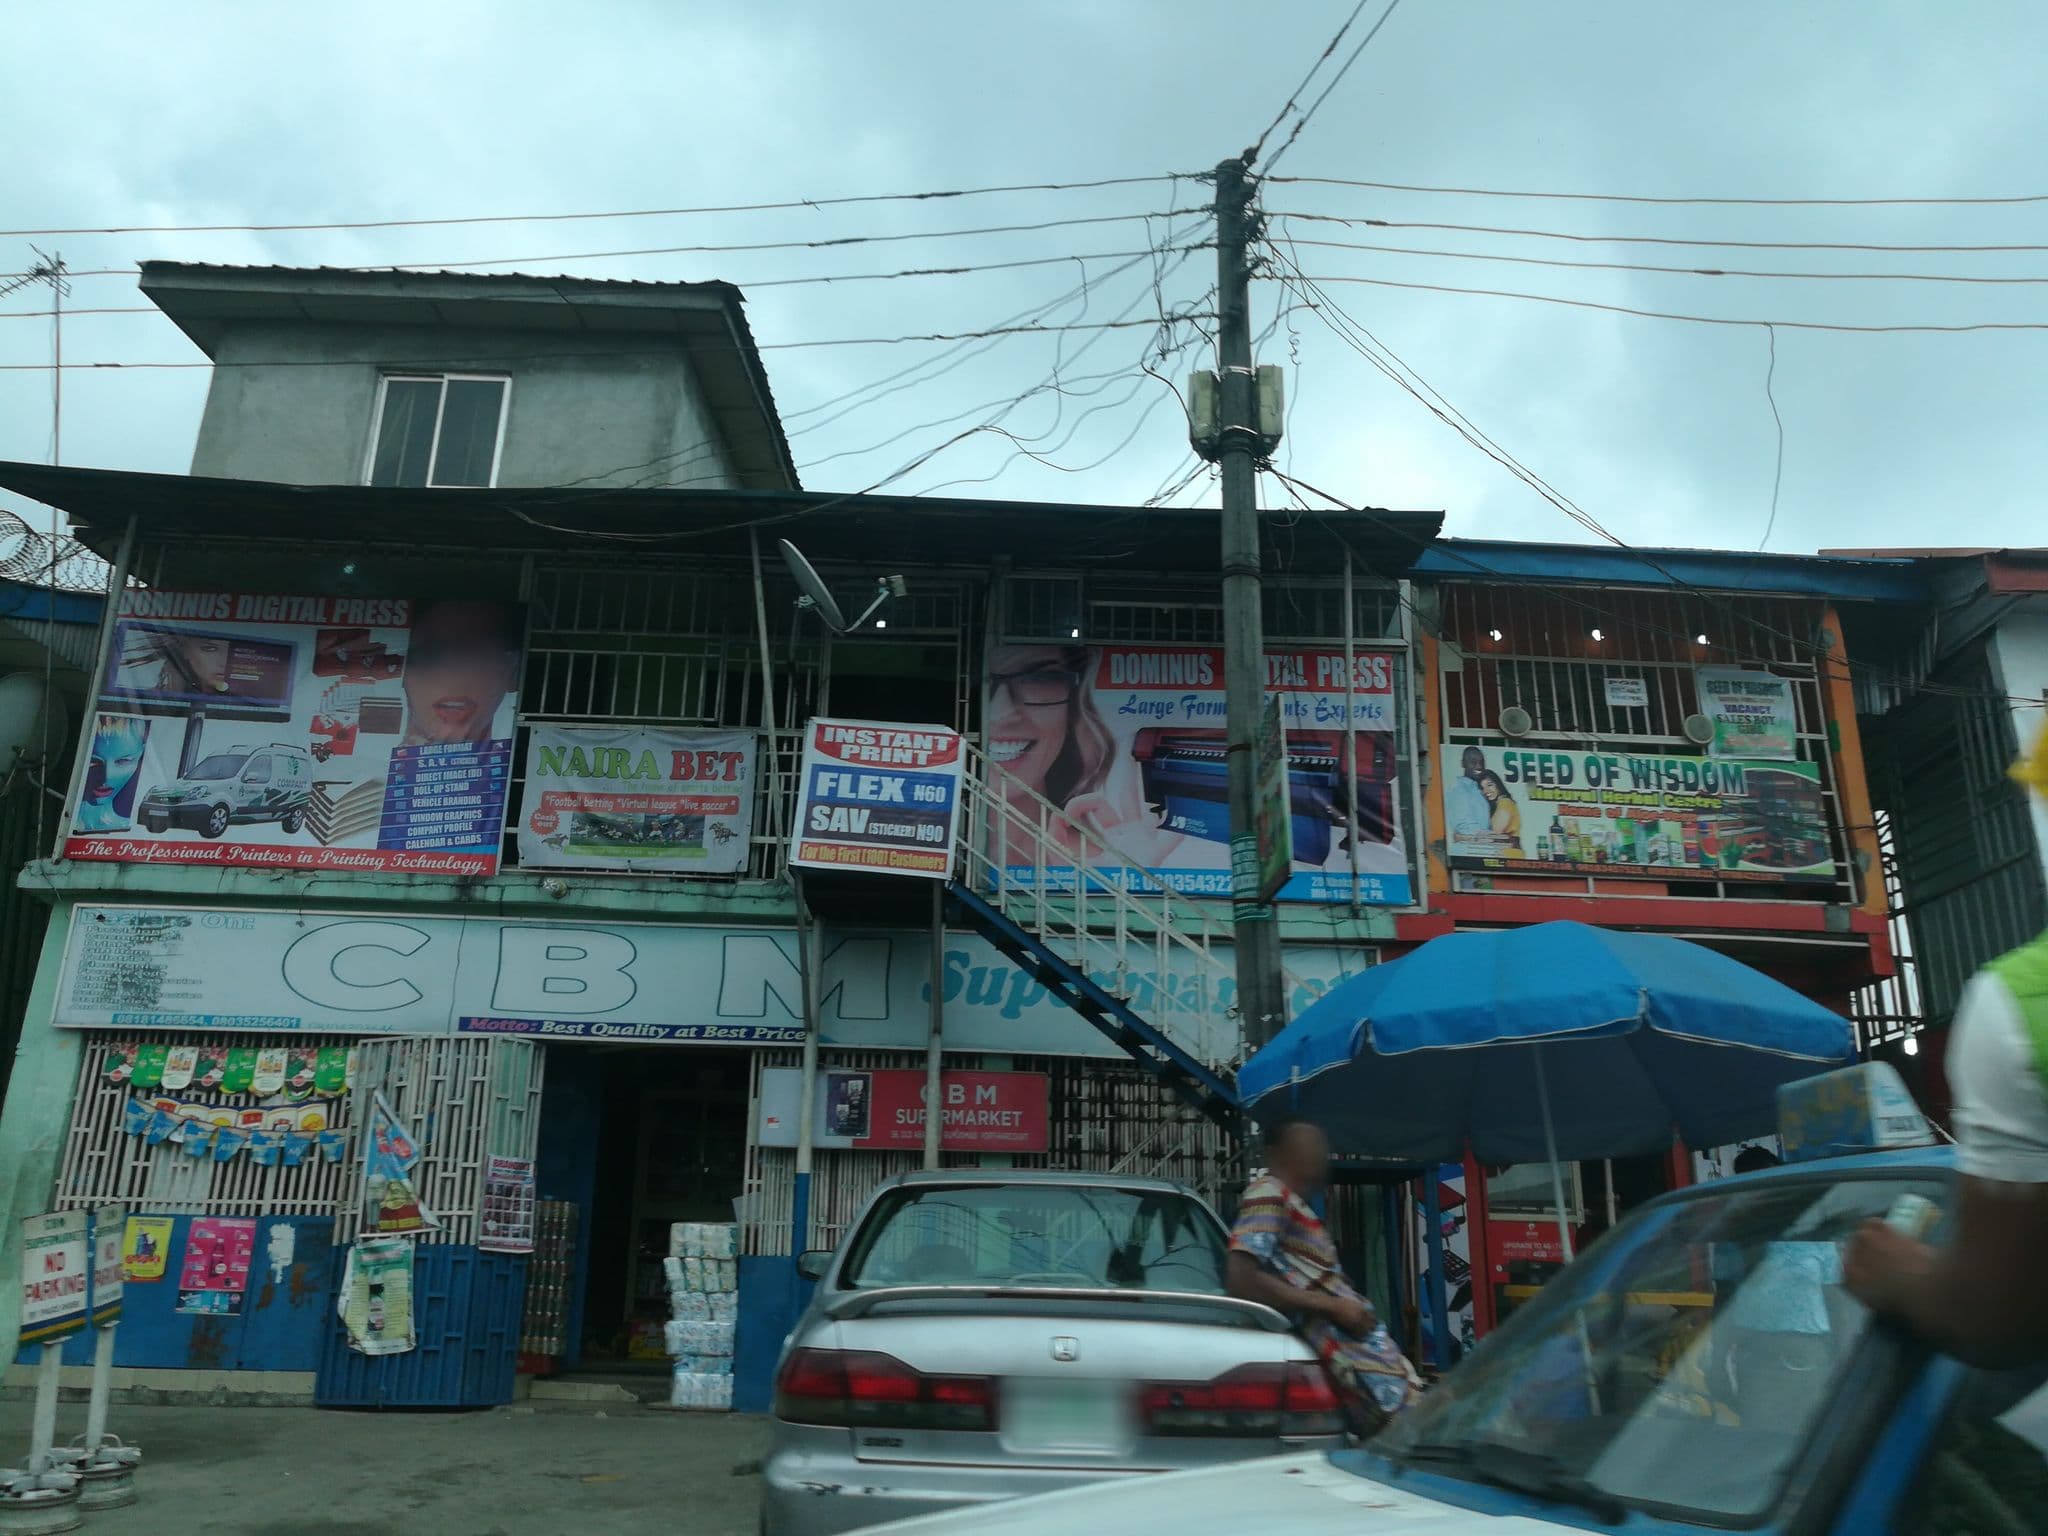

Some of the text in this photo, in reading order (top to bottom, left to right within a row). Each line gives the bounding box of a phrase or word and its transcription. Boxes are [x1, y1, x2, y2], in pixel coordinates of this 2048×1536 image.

[119, 591, 410, 626] DOMINUS DIGITAL PRESS
[1110, 652, 1215, 685] DOMINUS
[1317, 655, 1388, 689] PRESS
[1118, 694, 1173, 716] Large
[1181, 695, 1227, 719] Form
[824, 727, 953, 751] INSTANT
[537, 746, 662, 780] NAIRA
[670, 750, 745, 782] BET
[840, 744, 933, 766] PRINT
[416, 771, 442, 782] DIRECT
[1503, 751, 1749, 796] SEED OF WISDOM
[816, 771, 947, 803] FLEX N60
[1600, 789, 1661, 806] Herbal
[412, 795, 481, 808] VEHICLE BRANDING
[583, 797, 614, 810] betting
[410, 809, 482, 823] WINDOW GRAPHICS
[810, 805, 870, 834] SAV
[916, 824, 944, 843] N90
[408, 822, 473, 837] COMPANY PROFILE
[405, 837, 445, 850] CALENDAR
[454, 834, 482, 845] CARDS
[117, 841, 222, 866] Professional
[226, 845, 293, 865] Printers
[297, 848, 314, 864] in
[319, 849, 385, 871] Printing
[390, 851, 487, 874] Technology.
[889, 849, 945, 870] Customers
[469, 1018, 537, 1033] Motto:
[541, 1020, 585, 1035] Best
[591, 1022, 668, 1040] Quality
[675, 1025, 700, 1039] at
[703, 1025, 747, 1040] Best
[896, 1108, 1023, 1128] SUPRMARKET
